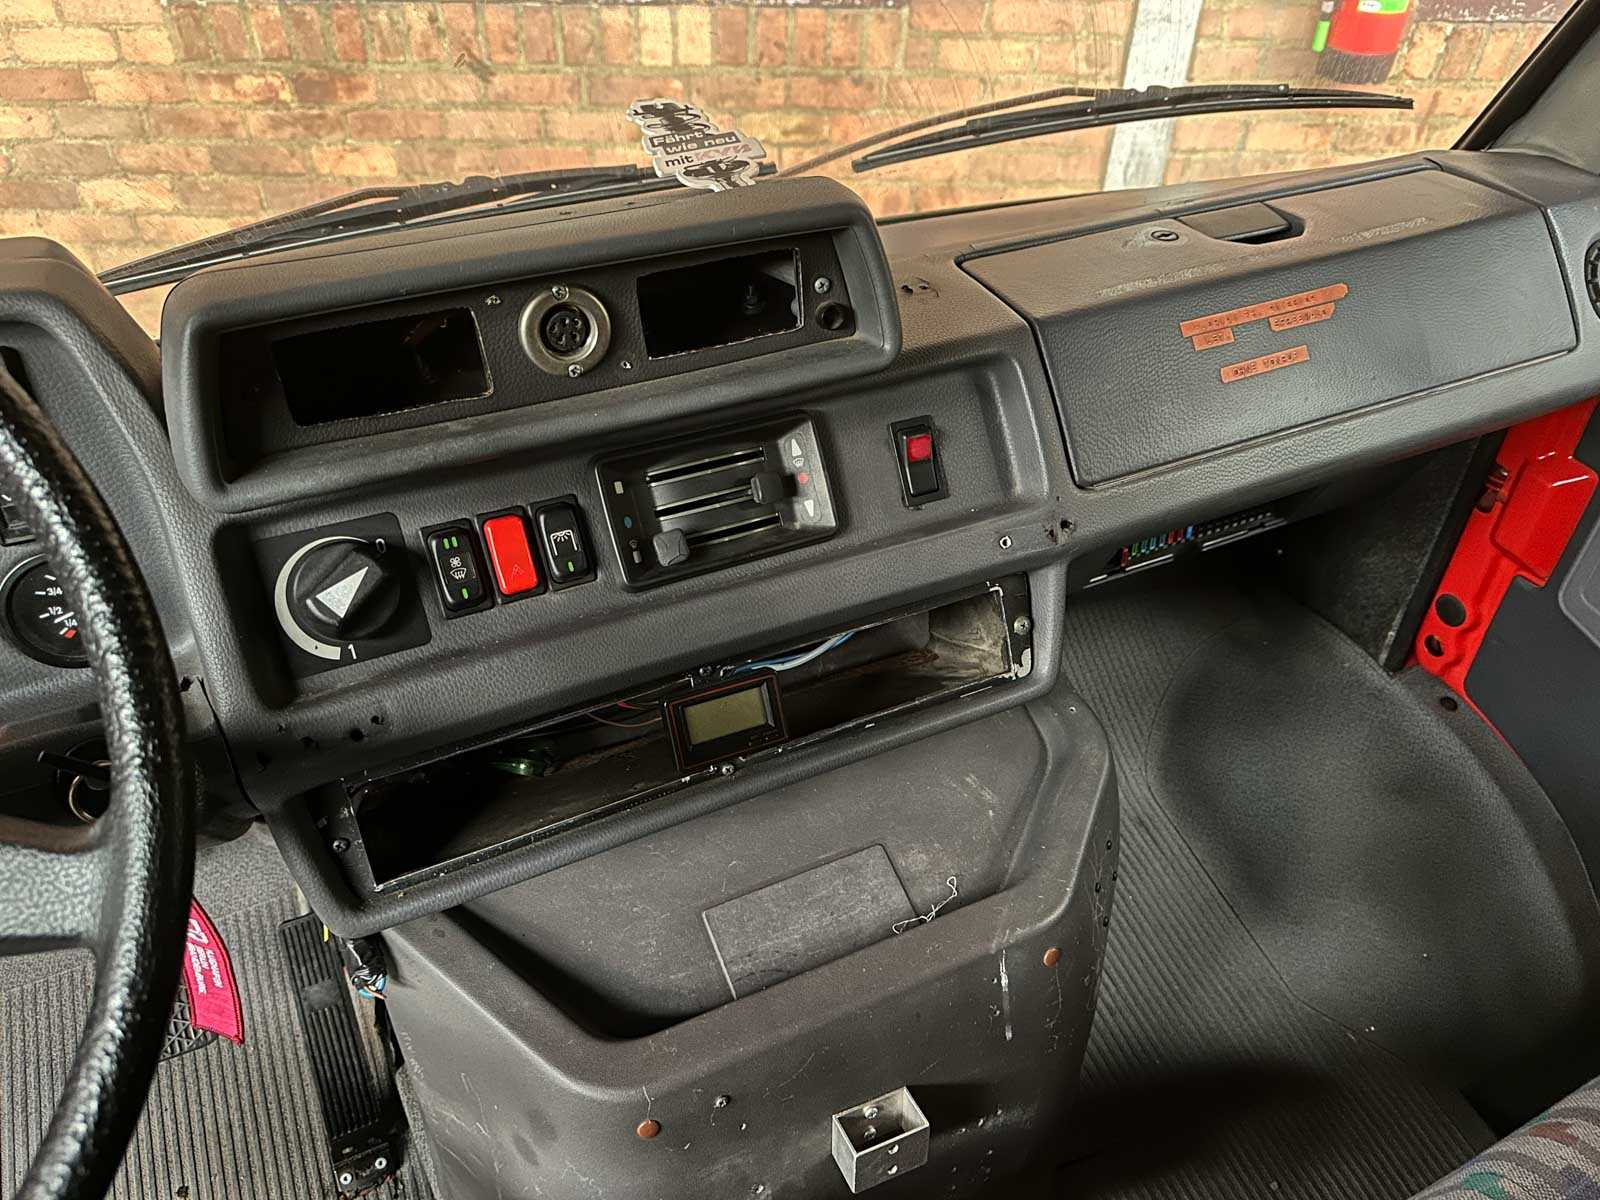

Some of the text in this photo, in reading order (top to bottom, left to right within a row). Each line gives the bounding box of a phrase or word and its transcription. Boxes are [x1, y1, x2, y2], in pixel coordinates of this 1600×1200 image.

[652, 130, 704, 146] Fährt
[666, 142, 698, 153] wie
[705, 135, 737, 147] neu
[664, 155, 694, 167] mit
[46, 587, 63, 596] 3/4
[48, 606, 63, 615] 1/2
[64, 619, 78, 627] 1/4
[347, 643, 357, 660] 1
